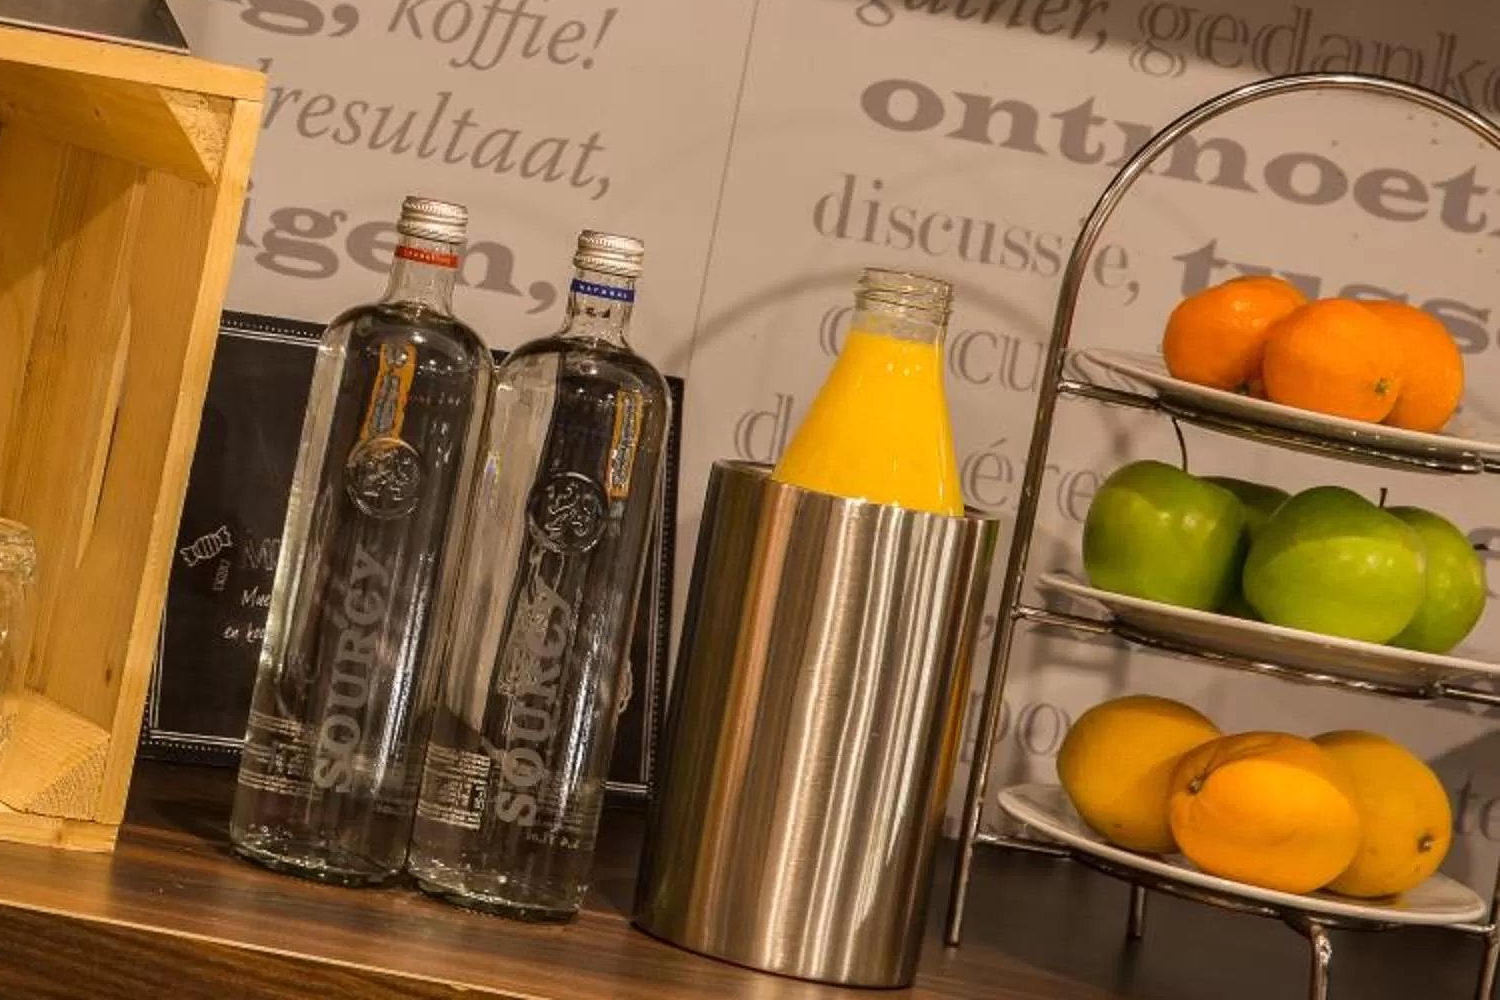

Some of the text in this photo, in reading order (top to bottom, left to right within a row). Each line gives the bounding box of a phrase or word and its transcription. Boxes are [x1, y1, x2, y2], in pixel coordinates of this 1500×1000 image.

[263, 85, 612, 202] resultaat,
[860, 77, 1500, 238] ontmoet
[812, 171, 1140, 306] discusse,
[313, 543, 389, 793] SOURCY
